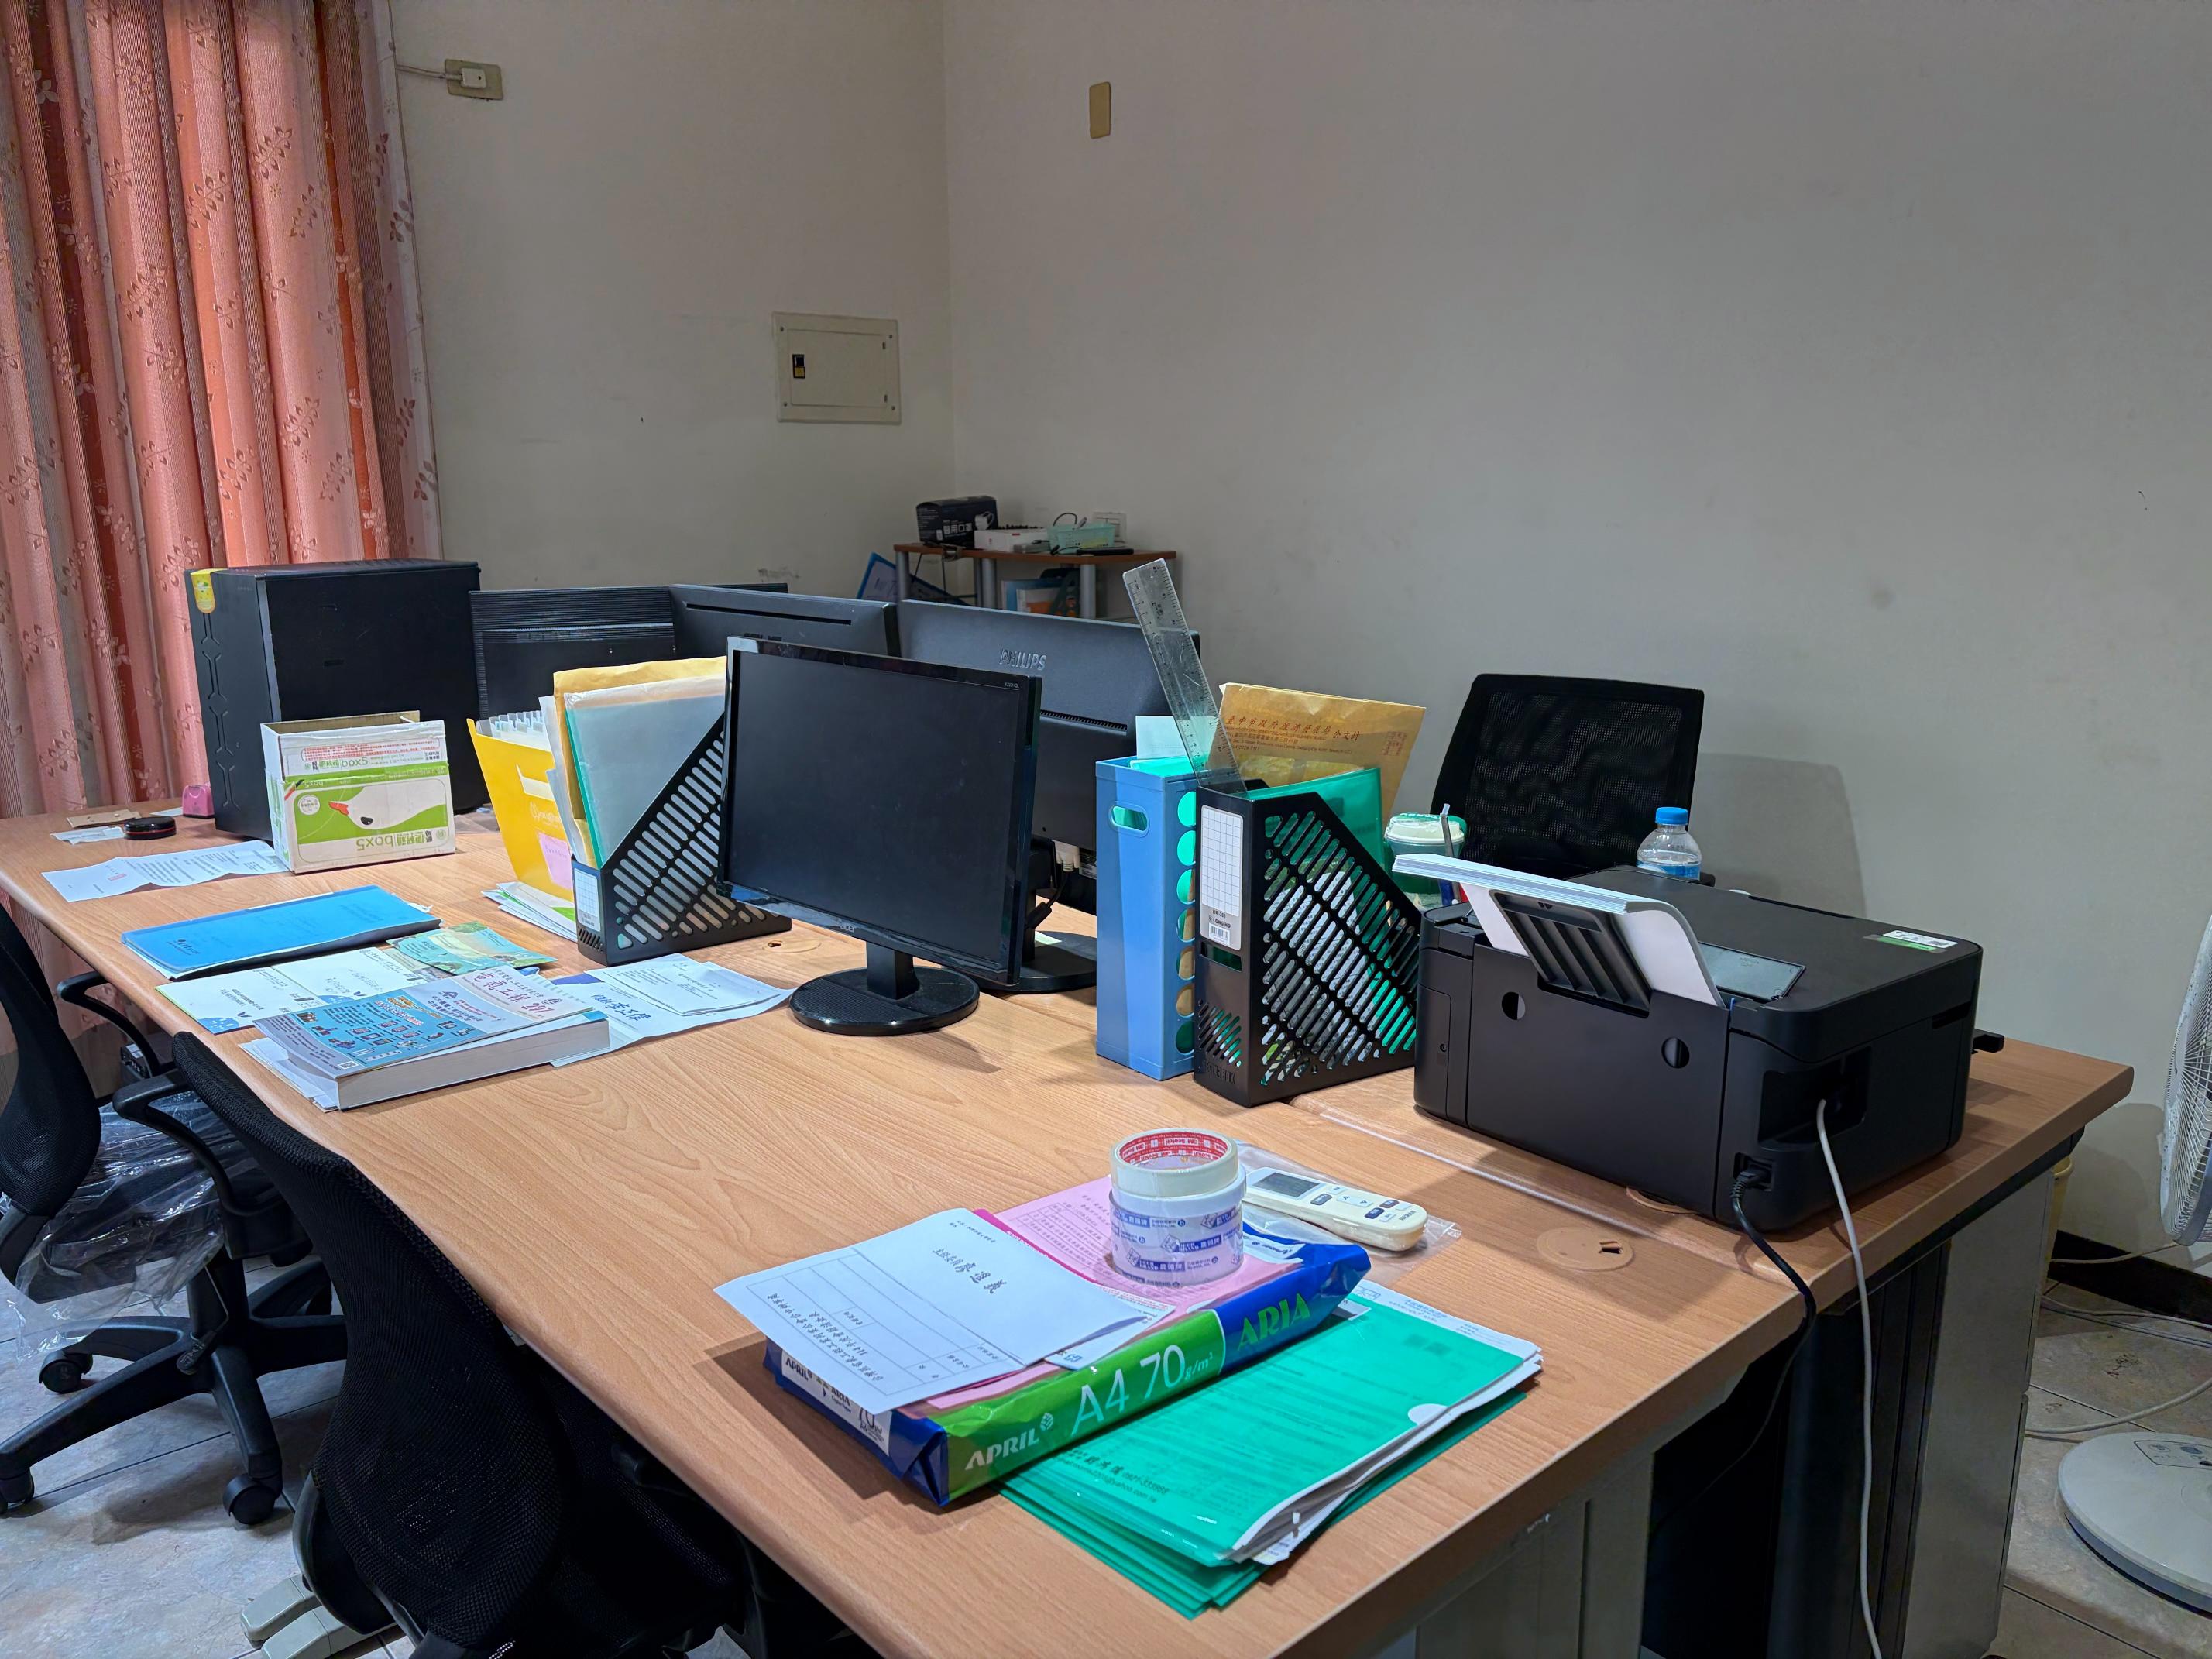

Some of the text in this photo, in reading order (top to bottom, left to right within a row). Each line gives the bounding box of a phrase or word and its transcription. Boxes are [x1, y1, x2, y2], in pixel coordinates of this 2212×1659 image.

[998, 649, 1048, 672] PHILIPS
[1332, 730, 1361, 741] 公文封
[342, 757, 369, 768] box5
[356, 834, 393, 851] box5
[840, 922, 857, 933] acer
[474, 971, 555, 1015] 電氣工程 297
[1237, 1292, 1311, 1350] ARIA
[785, 1356, 809, 1382] APRIL
[965, 1427, 1041, 1471] APRIL
[1070, 1368, 1129, 1436] A4
